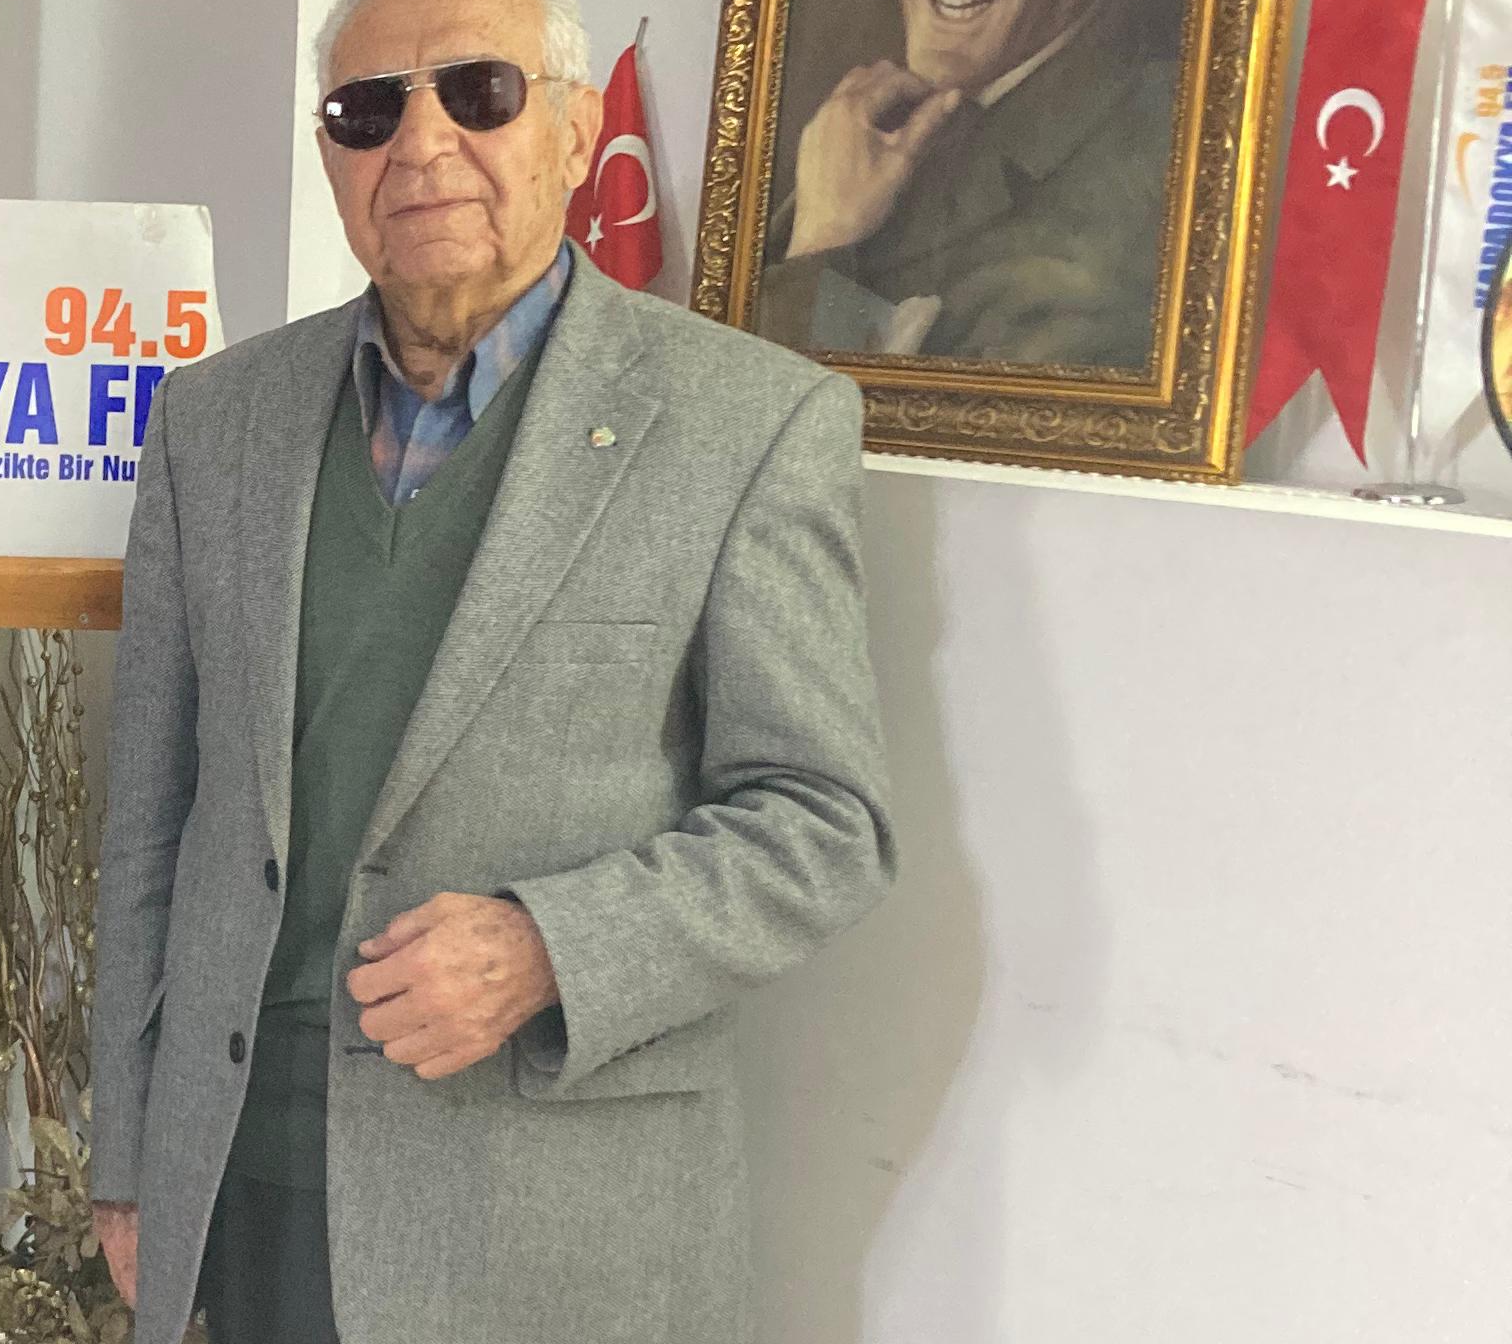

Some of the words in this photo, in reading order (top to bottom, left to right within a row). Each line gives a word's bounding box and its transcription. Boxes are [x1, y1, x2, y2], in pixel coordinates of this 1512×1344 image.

[43, 285, 209, 360] 94.5
[58, 453, 94, 481] Bir
[101, 455, 136, 482] Nu
